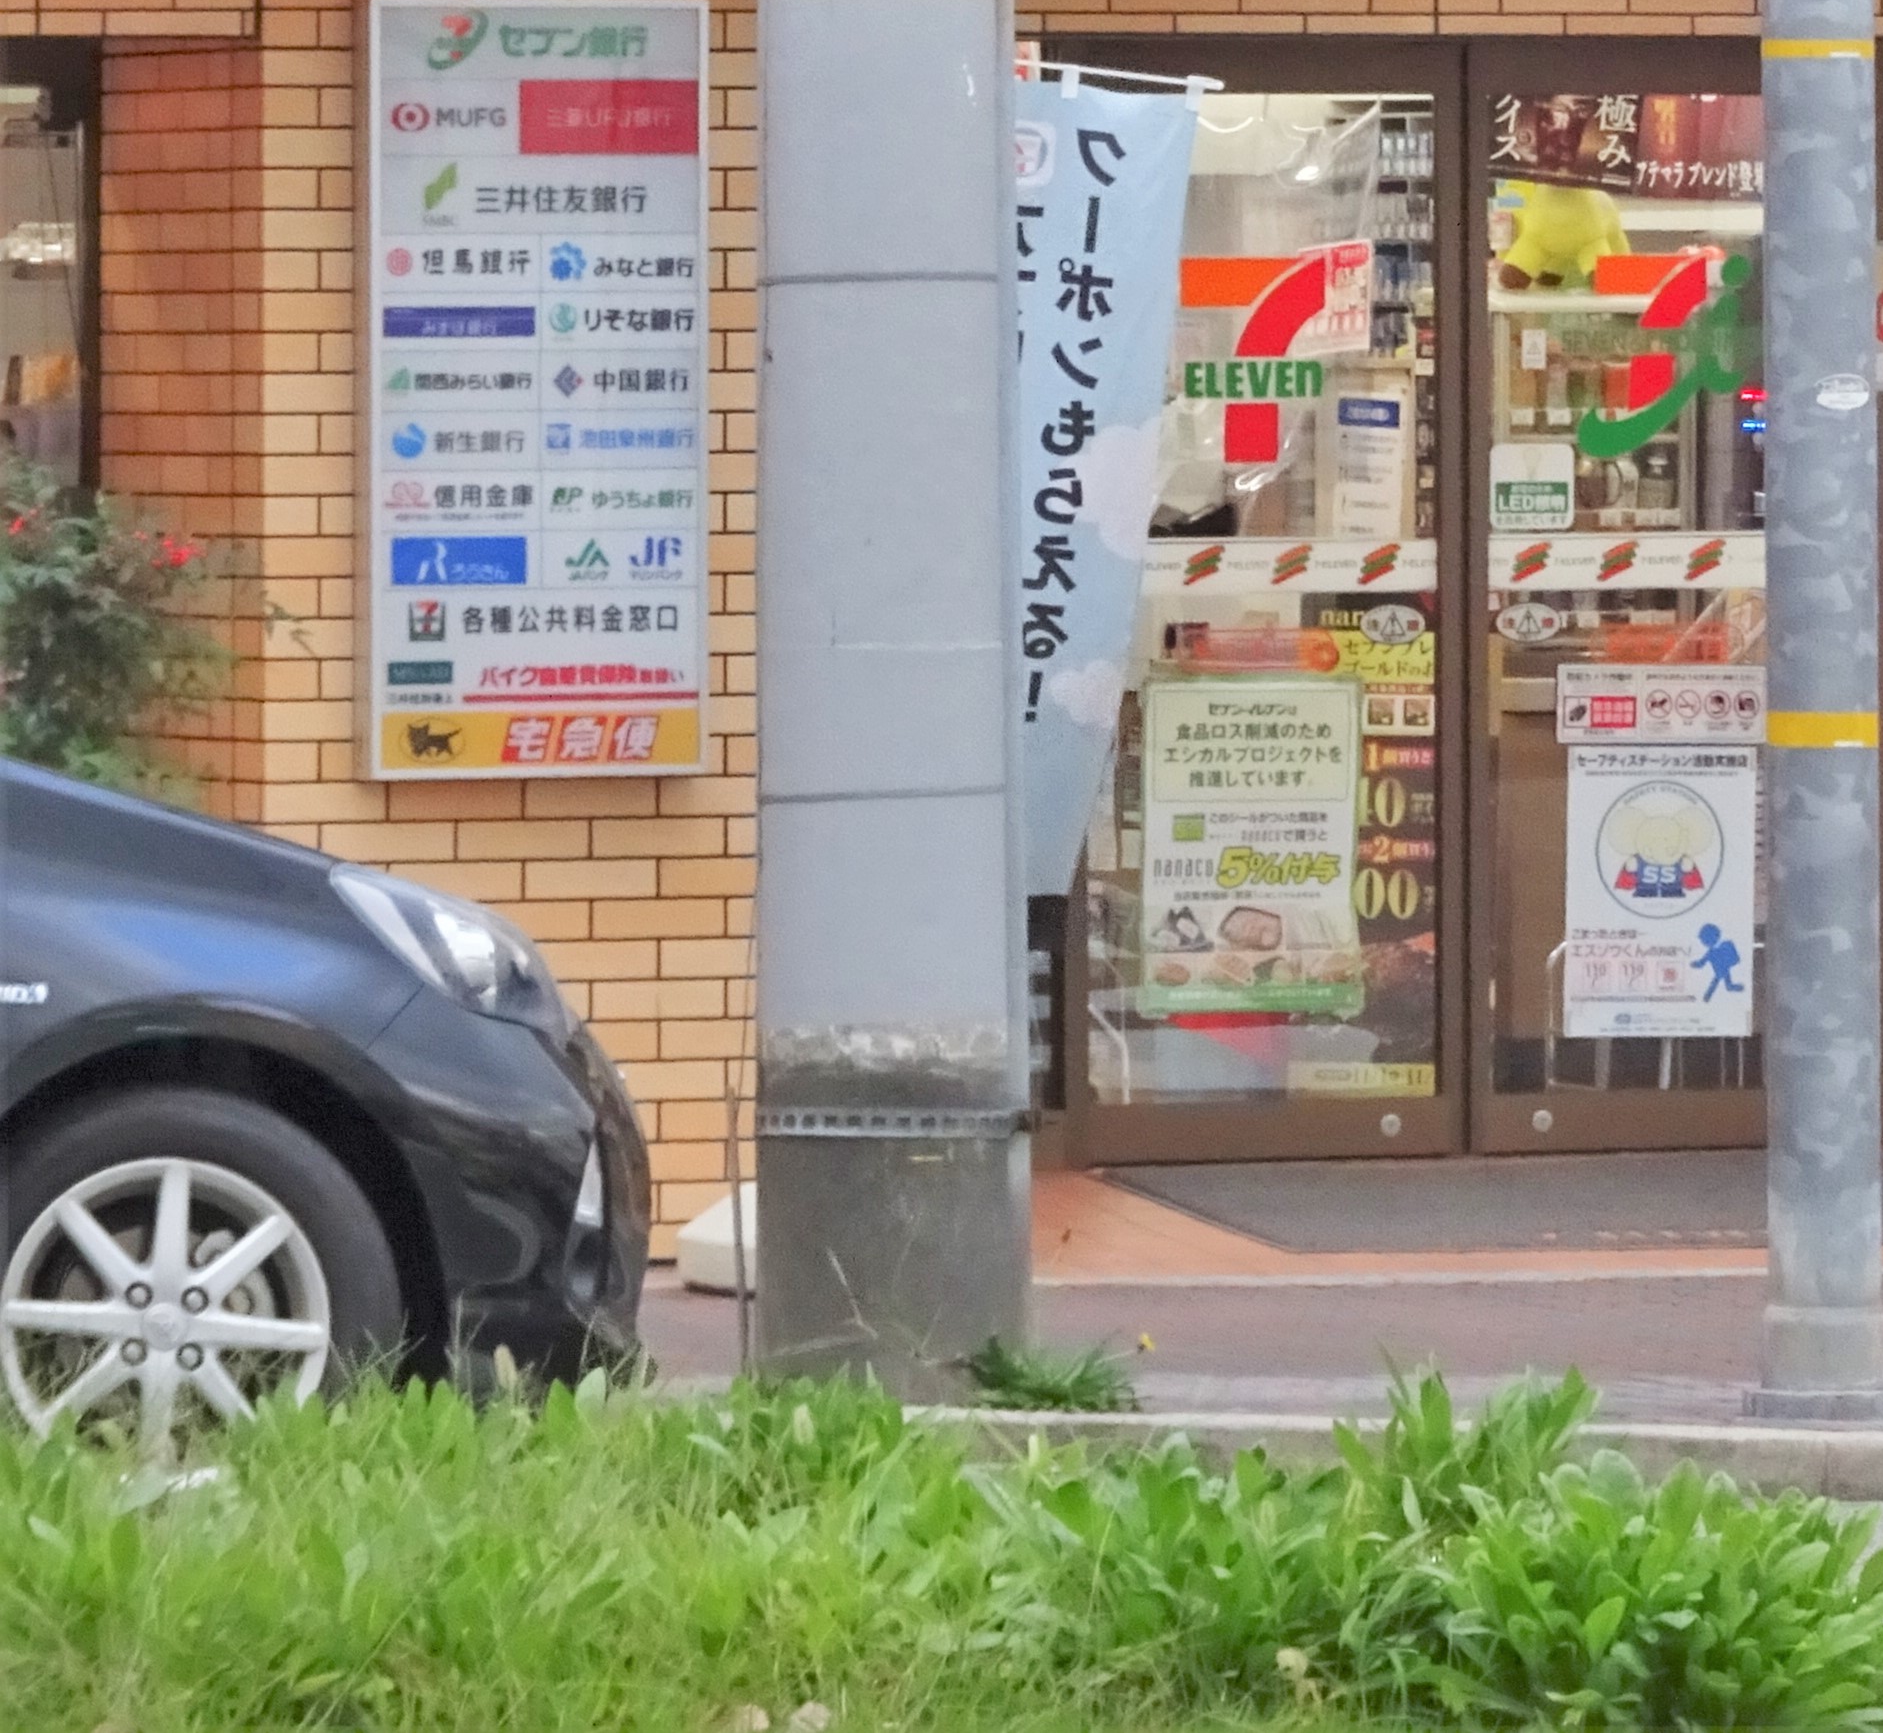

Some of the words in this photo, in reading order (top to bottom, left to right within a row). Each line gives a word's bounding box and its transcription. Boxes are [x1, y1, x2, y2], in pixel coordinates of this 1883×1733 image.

[498, 25, 648, 58] セブン銀行
[436, 107, 507, 128] MUFG
[1595, 94, 1639, 168] 極み
[474, 184, 648, 215] 三井住友銀行
[422, 248, 531, 275] 但馬銀行
[593, 256, 695, 279] みなと銀行
[583, 308, 695, 333] りそな銀行
[593, 368, 689, 394] 中国銀行
[433, 429, 526, 455] 新生銀行
[434, 483, 534, 509] 信用金庫
[591, 488, 694, 510] ゆうちょ銀行
[461, 602, 680, 636] 各種公共料金窓口
[502, 715, 660, 763] 宅急便
[1176, 722, 1332, 741] 食品ロス削減のため
[1163, 746, 1343, 764] エシカルプロジェクトを
[1641, 865, 1677, 884] SS
